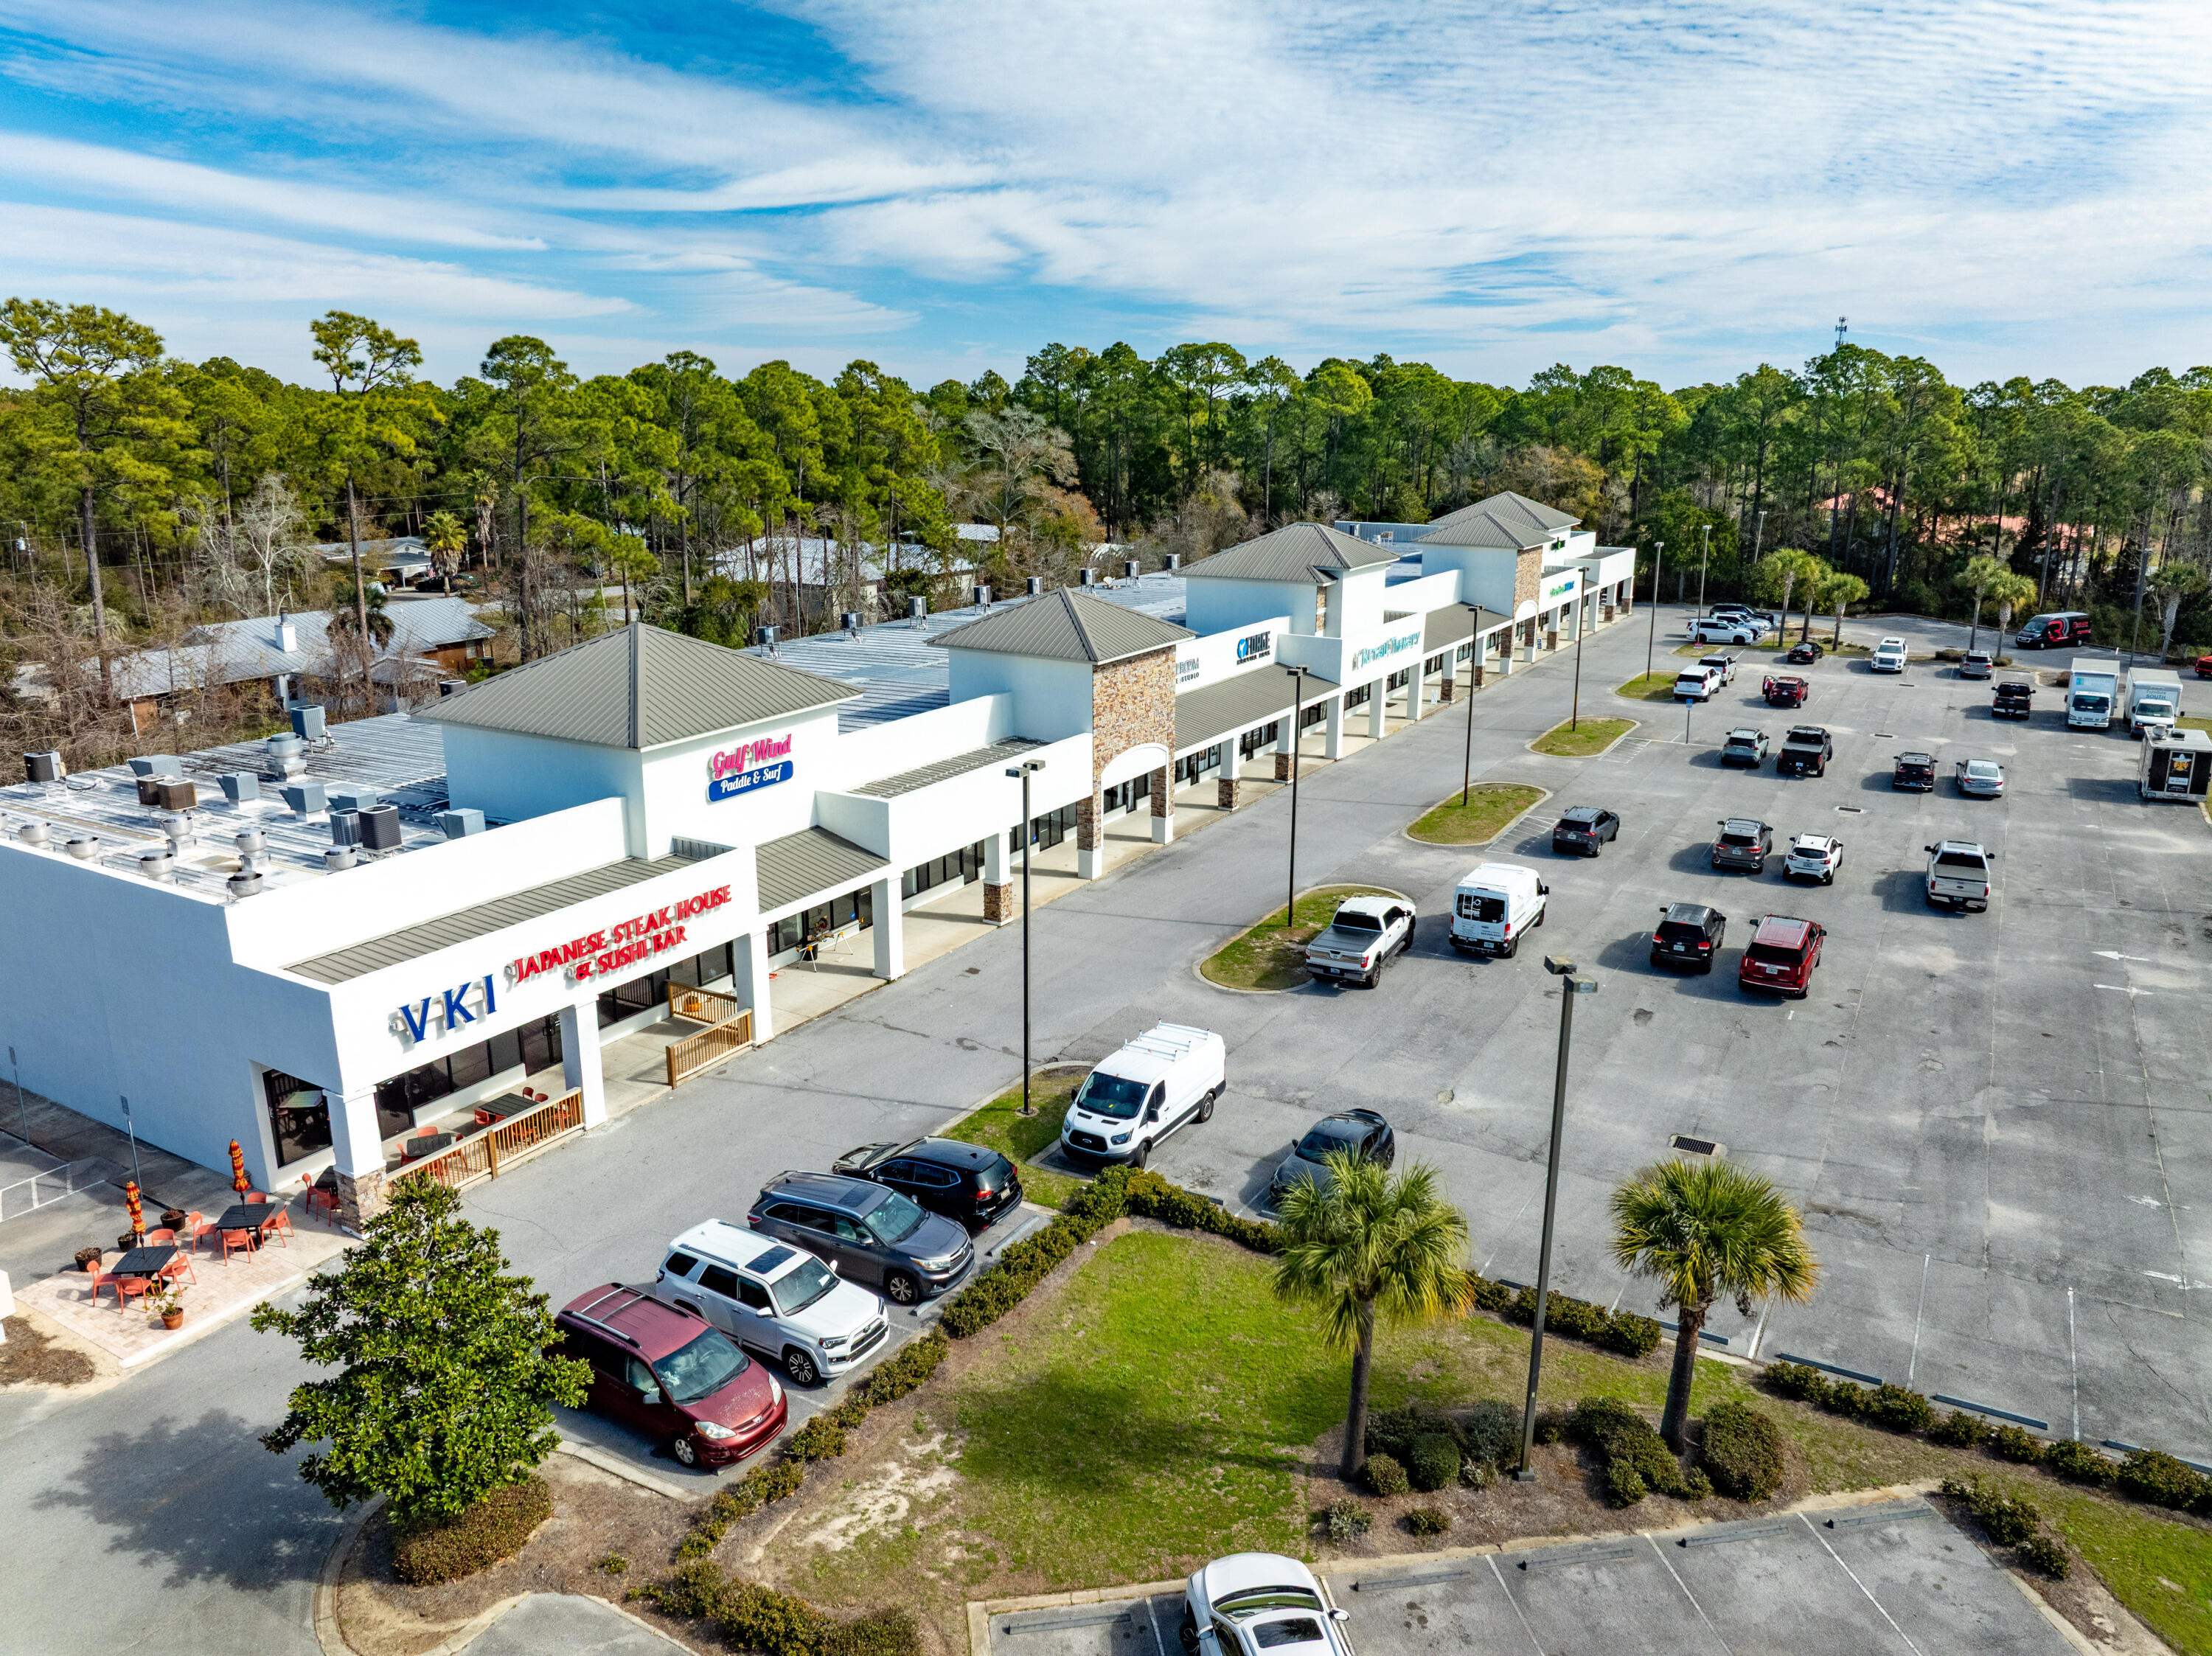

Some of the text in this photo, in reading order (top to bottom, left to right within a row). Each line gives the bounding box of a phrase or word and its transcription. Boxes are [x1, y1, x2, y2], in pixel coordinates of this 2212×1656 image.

[1245, 631, 1270, 655] FORGE
[1181, 672, 1200, 683] STUDIO
[713, 734, 792, 779] Gulf Wind
[720, 765, 782, 793] Paddle & Surf
[514, 884, 732, 984] JAPANESE STEAK HOUSE
[575, 925, 688, 981] & SUSHI BAR
[397, 973, 498, 1044] VKI
